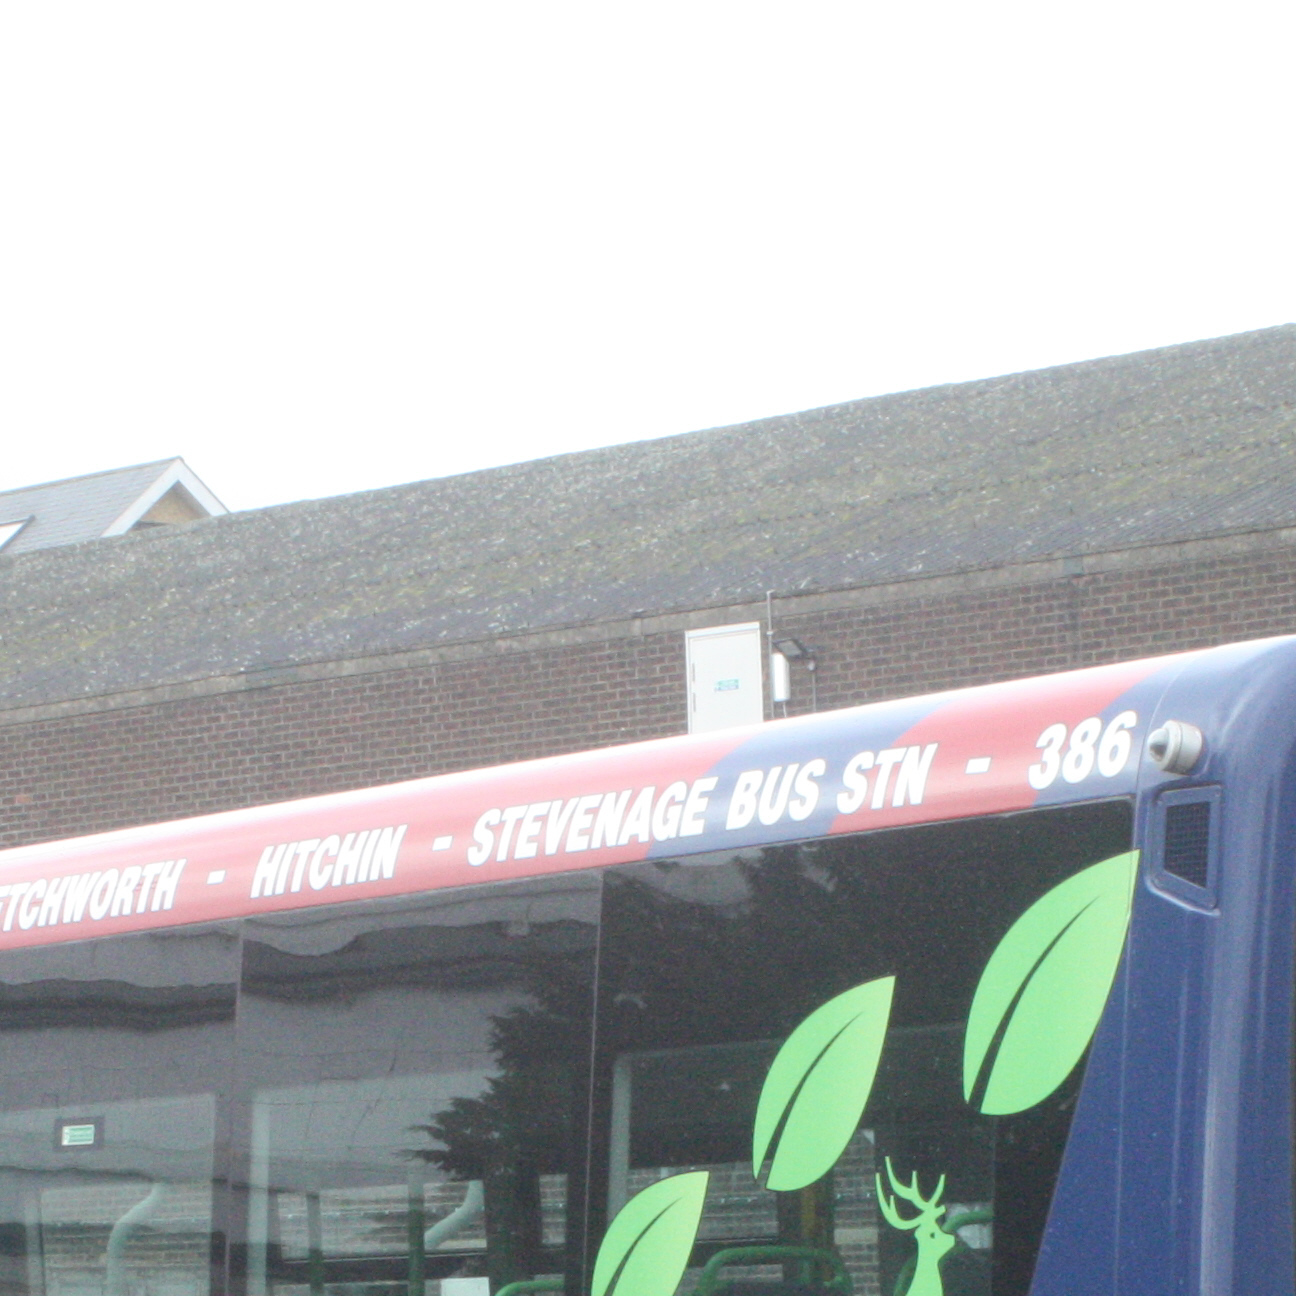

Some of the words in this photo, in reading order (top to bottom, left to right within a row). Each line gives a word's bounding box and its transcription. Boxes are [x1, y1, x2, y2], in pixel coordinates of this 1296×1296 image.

[250, 824, 407, 899] HITCHIN
[468, 776, 718, 867] STEVENAGE
[726, 758, 826, 831] BUS
[837, 743, 938, 815] STN
[1028, 710, 1137, 790] 386
